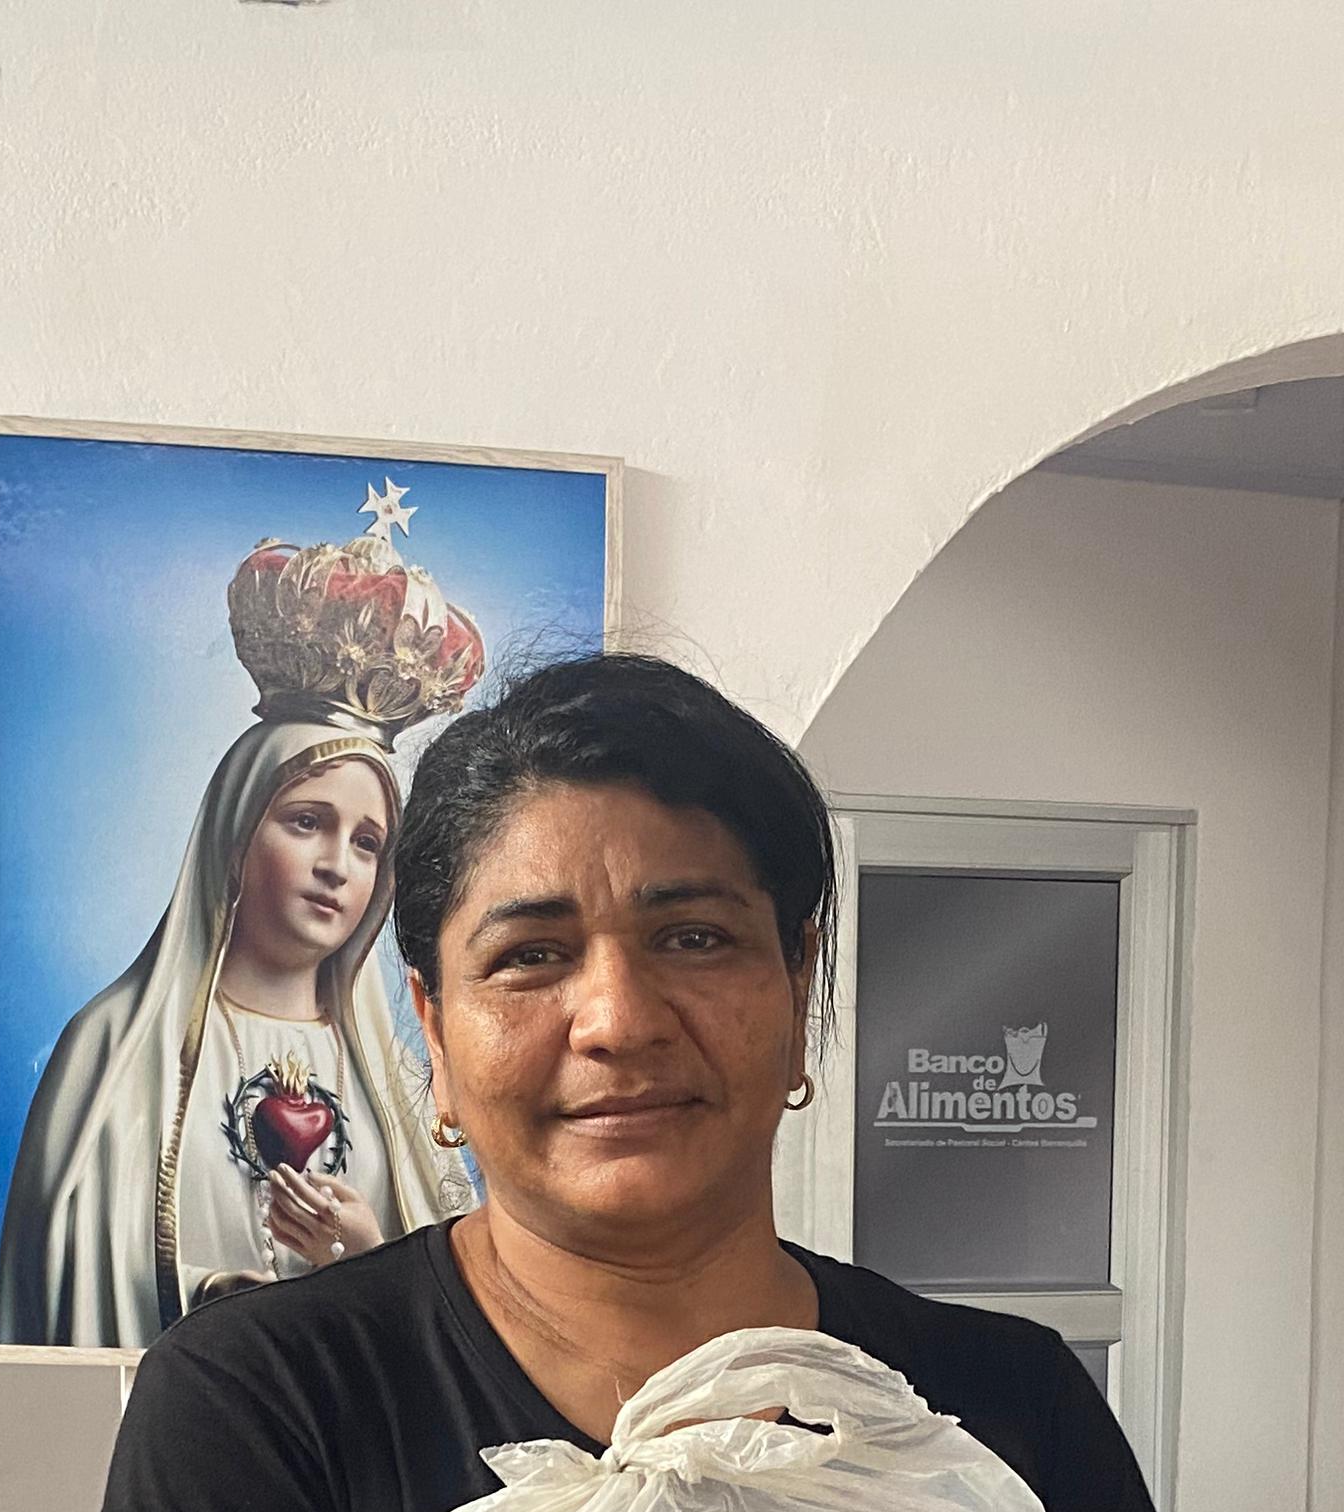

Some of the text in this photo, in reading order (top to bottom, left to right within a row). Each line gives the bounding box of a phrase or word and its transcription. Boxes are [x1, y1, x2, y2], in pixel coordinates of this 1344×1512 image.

[908, 1048, 1004, 1074] Banco
[972, 1075, 997, 1091] de
[876, 1081, 1078, 1121] Alimentos
